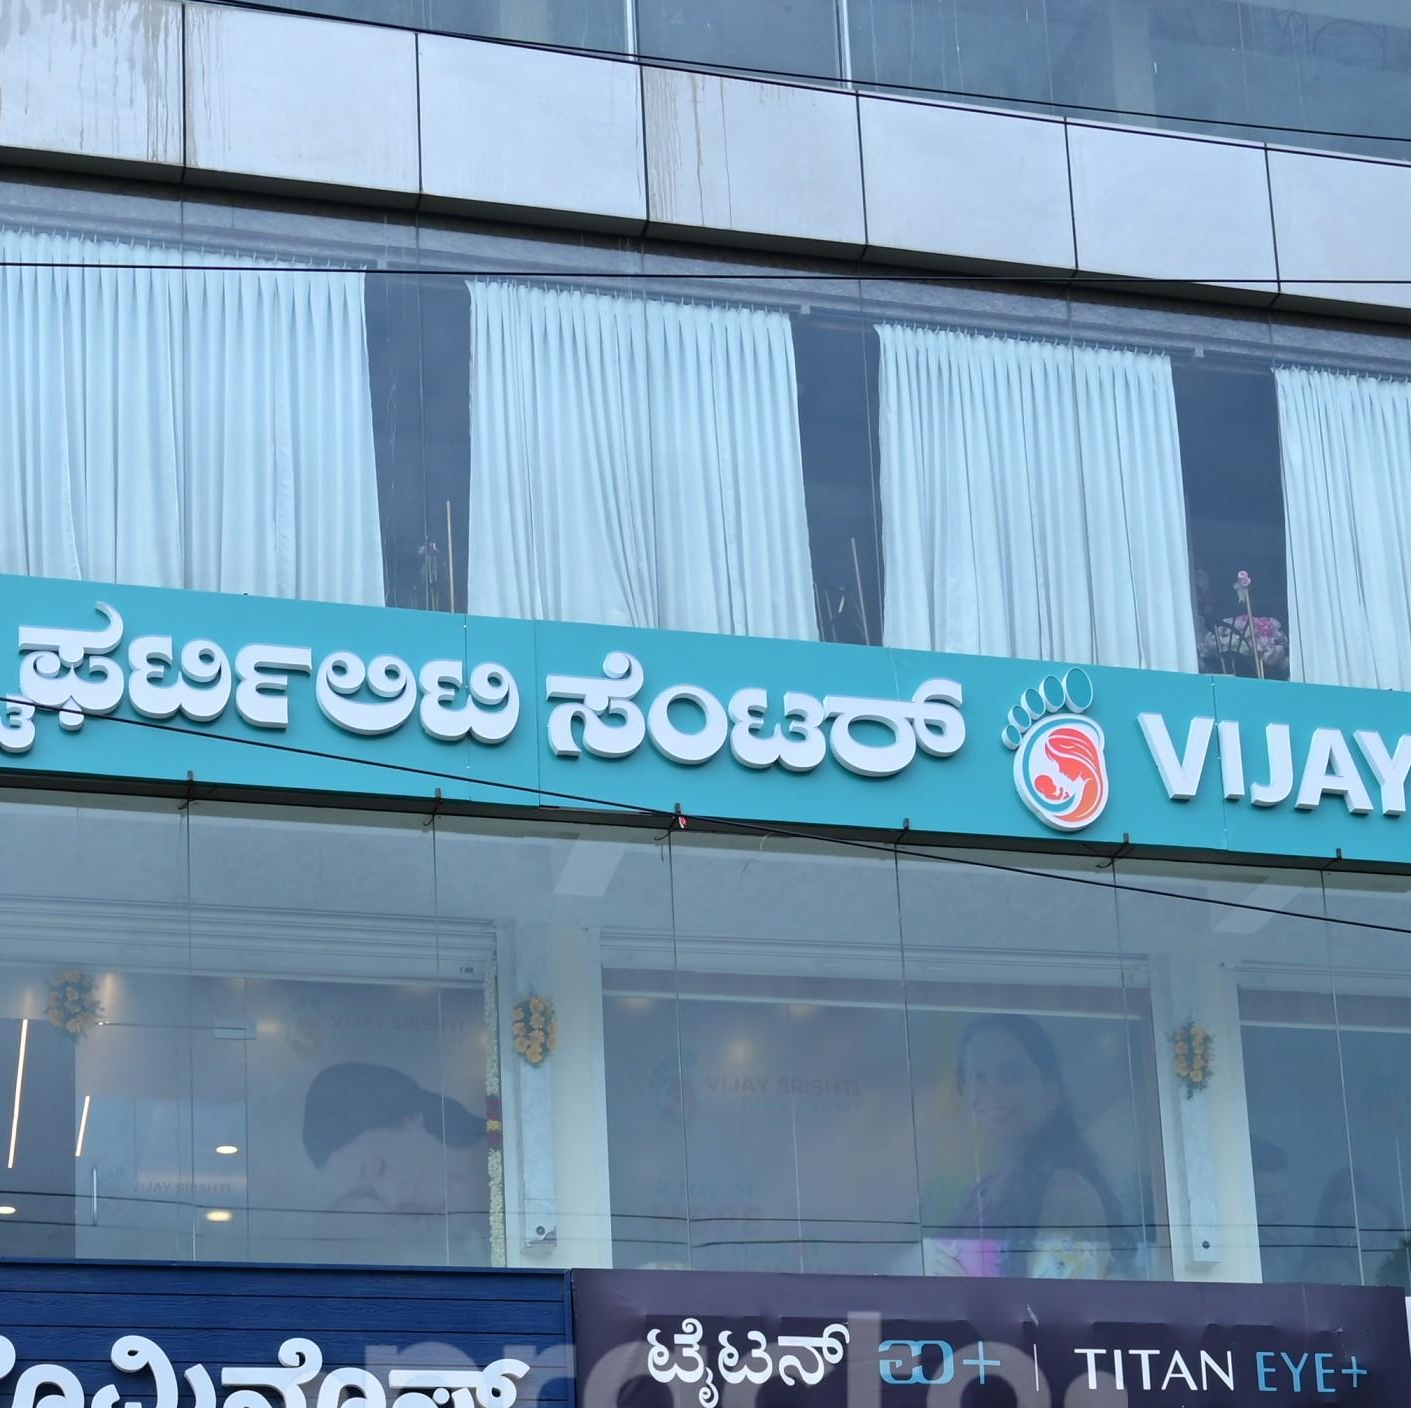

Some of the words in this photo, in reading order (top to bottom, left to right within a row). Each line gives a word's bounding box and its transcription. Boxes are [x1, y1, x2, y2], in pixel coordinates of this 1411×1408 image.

[18, 601, 521, 745] ಫರ್ಟಿಲಿಟಿ
[545, 650, 966, 778] ಸೆಂಟರ್
[705, 1074, 770, 1094] VIJAY
[777, 1077, 861, 1097] SRISHTI
[1074, 1348, 1236, 1392] TITAN
[1256, 1350, 1369, 1394] EYE+
